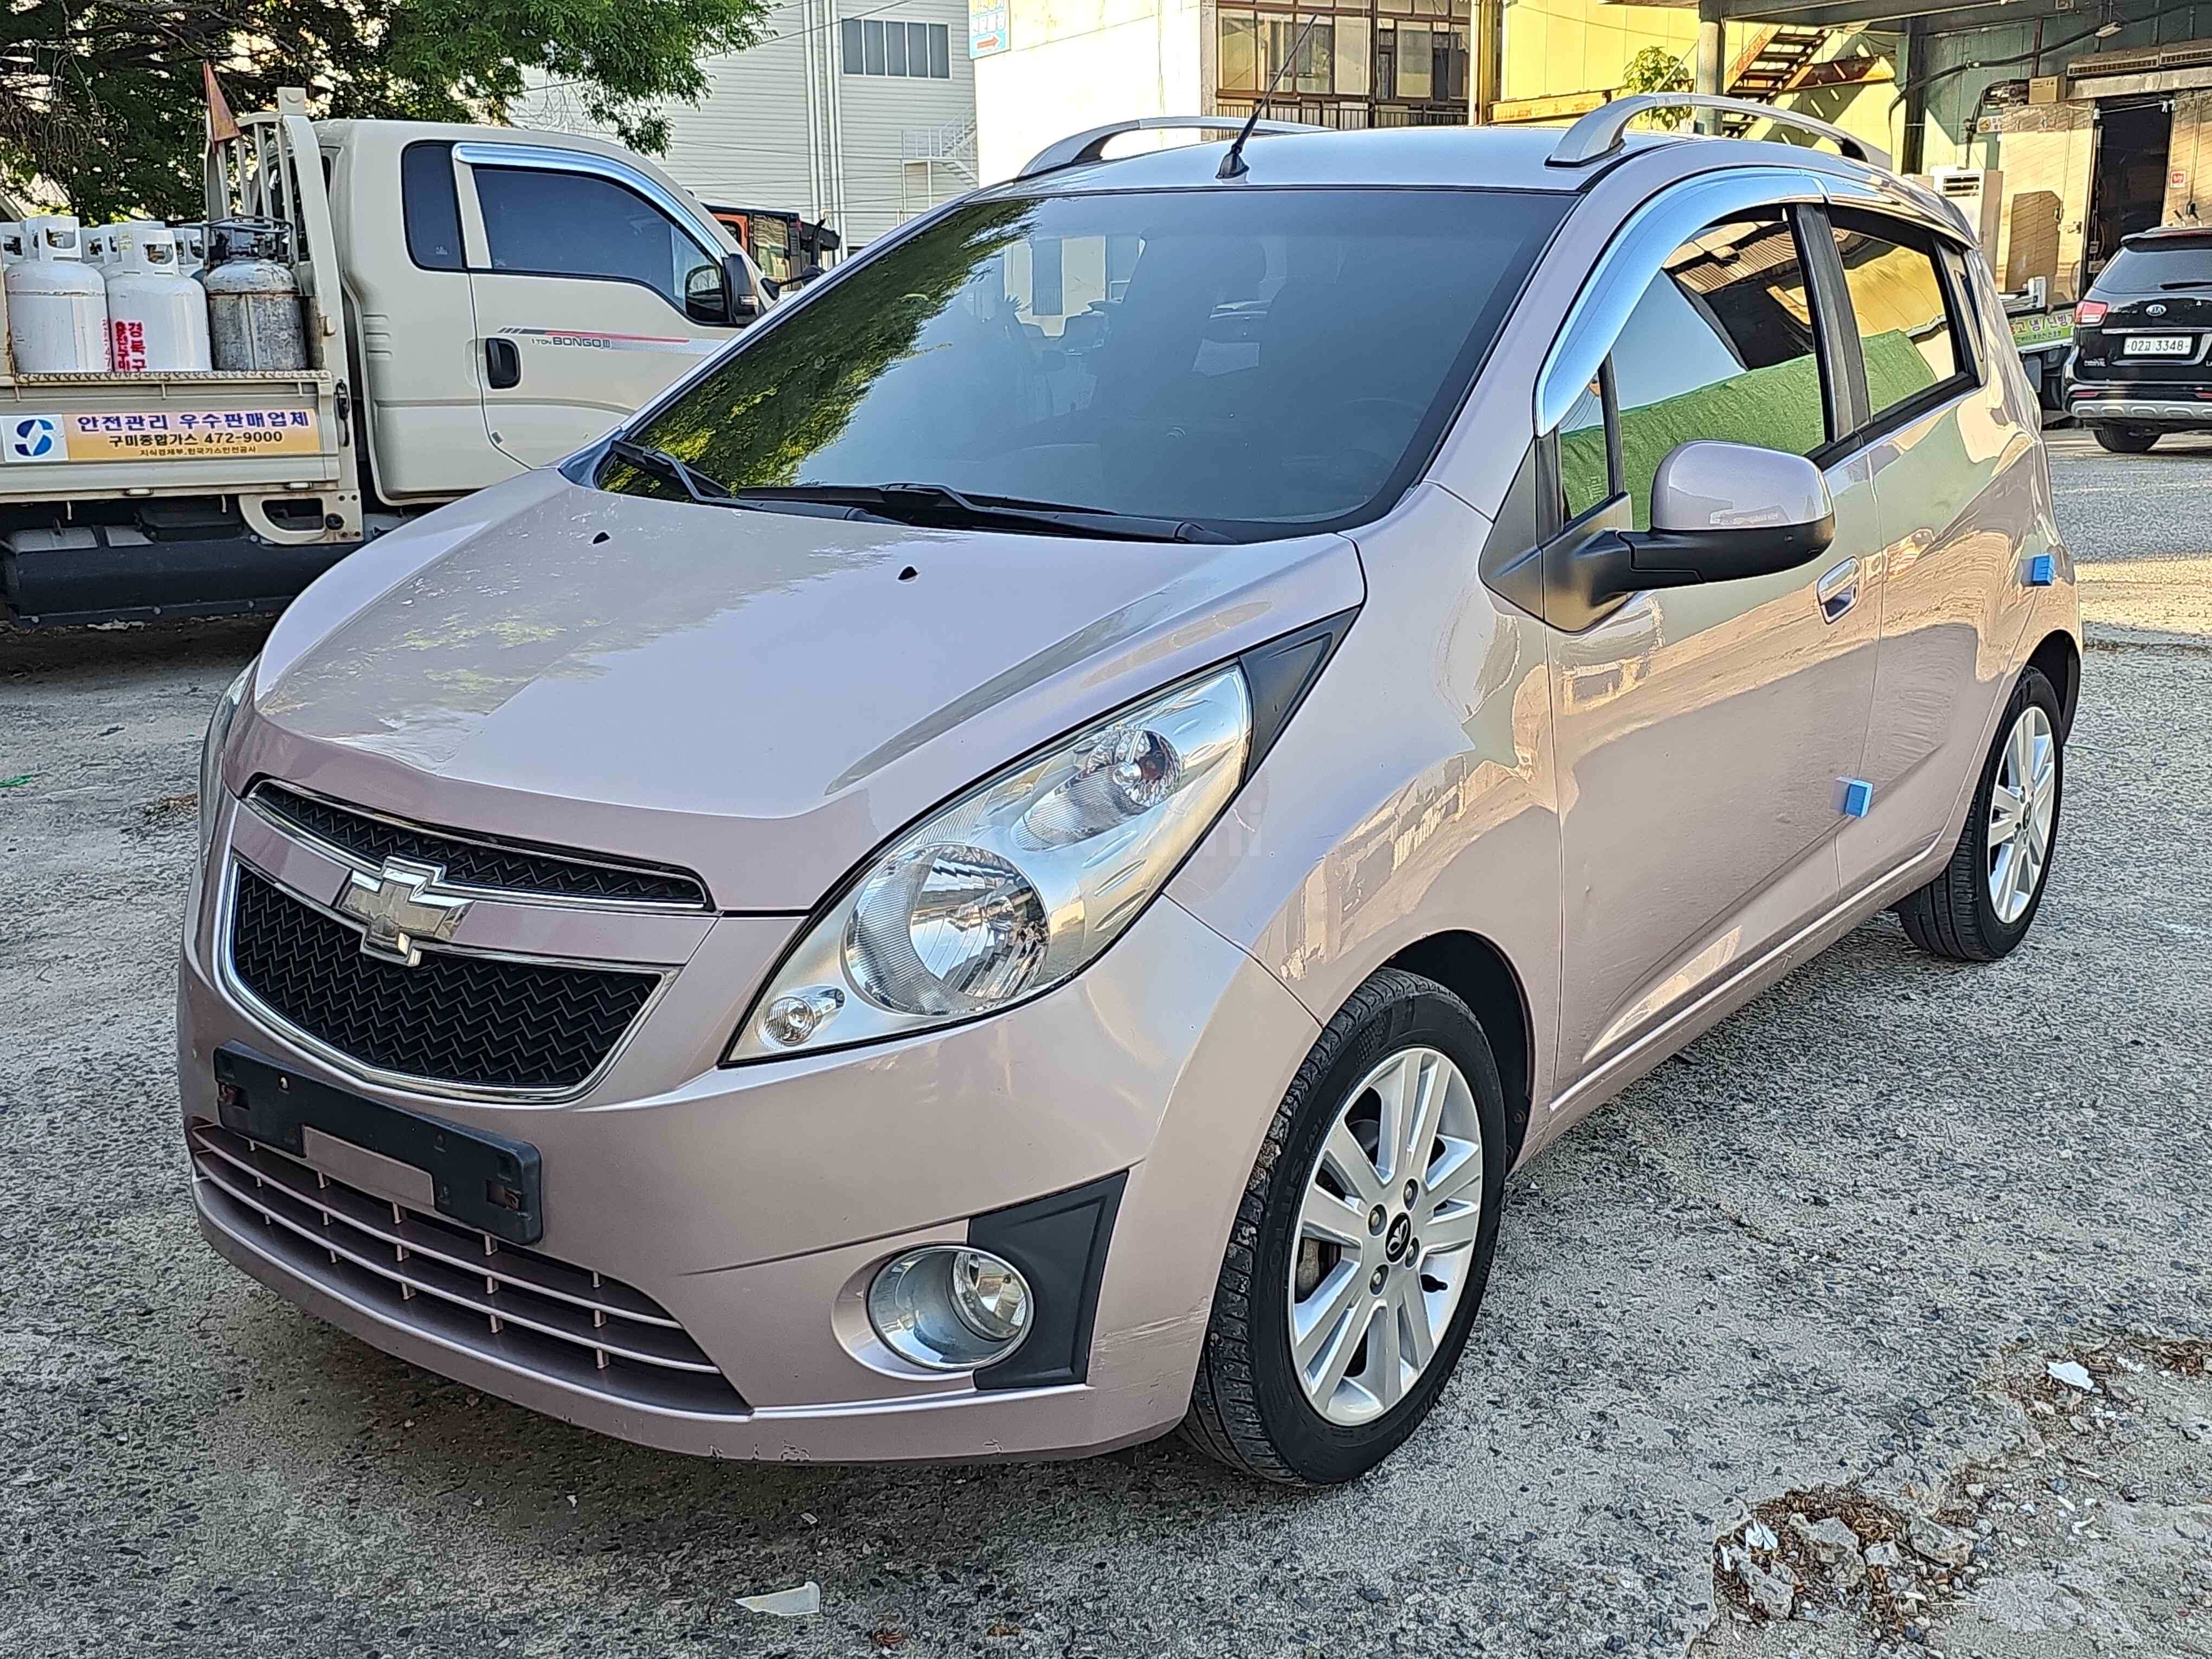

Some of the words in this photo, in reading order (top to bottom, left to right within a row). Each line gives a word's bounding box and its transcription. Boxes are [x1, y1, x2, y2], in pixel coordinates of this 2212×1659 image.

[553, 337, 601, 348] BONGO
[2156, 340, 2184, 351] 3348
[78, 415, 169, 432] 안전관리
[179, 411, 309, 429] 우수판매업체
[110, 433, 198, 447] 구미종합가스
[204, 431, 283, 443] 472-9000
